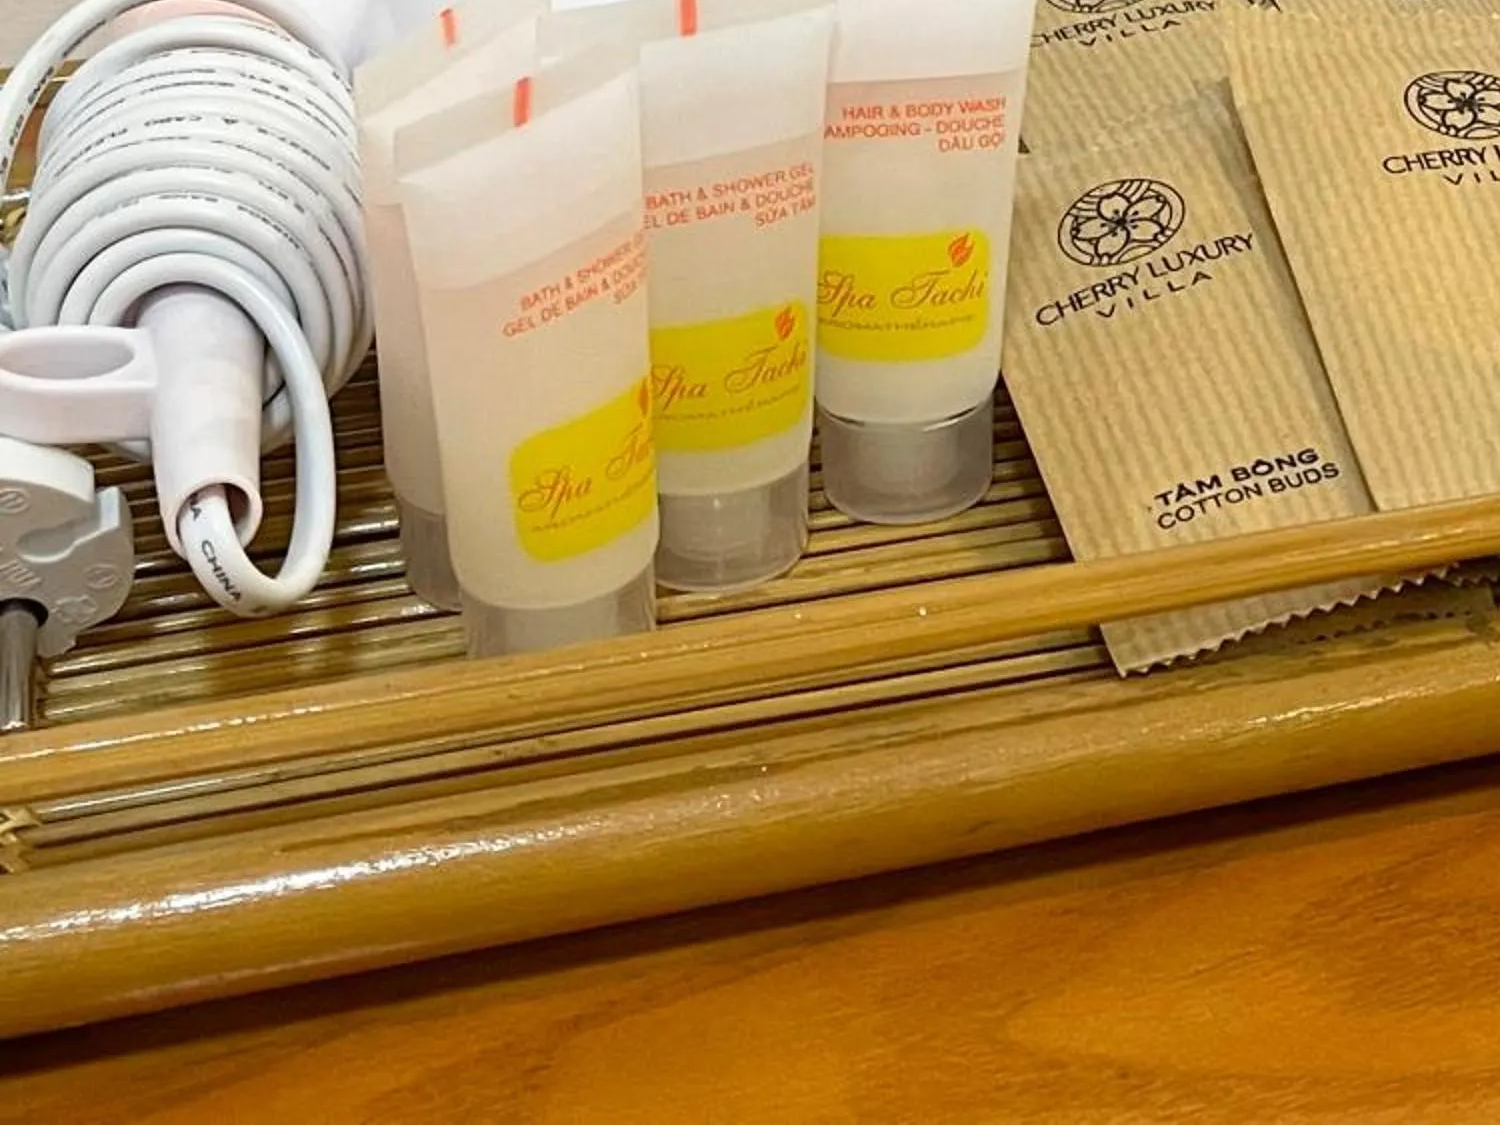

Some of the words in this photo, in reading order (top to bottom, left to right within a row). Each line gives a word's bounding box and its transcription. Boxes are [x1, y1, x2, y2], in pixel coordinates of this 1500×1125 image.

[1124, 0, 1216, 22] LUXURY
[1079, 20, 1181, 46] VILLA
[824, 122, 920, 139] AMPOOING
[936, 114, 1005, 135] DOUCHE
[841, 104, 883, 120] HAIR
[889, 104, 900, 118] &
[906, 102, 953, 118] BODY
[957, 96, 1006, 114] WASH
[1383, 146, 1486, 174] CHERRY
[645, 191, 691, 210] BATH
[712, 171, 785, 198] SHOWER
[667, 211, 688, 225] DE
[696, 202, 735, 220] BAIN
[521, 283, 561, 311] BATH
[817, 269, 878, 317] Spa
[890, 268, 988, 309] Tachi
[1035, 266, 1140, 326] CHERRY
[1147, 233, 1253, 278] LUXURY
[1096, 270, 1214, 318] VILLA
[502, 317, 535, 336] GEL
[541, 304, 561, 322] DE
[566, 284, 598, 311] BAIN
[650, 364, 708, 411] Spa
[518, 465, 592, 519] Spa
[1157, 483, 1263, 530] COTTON
[1268, 462, 1340, 494] BUDS
[201, 540, 242, 603] CHINA
